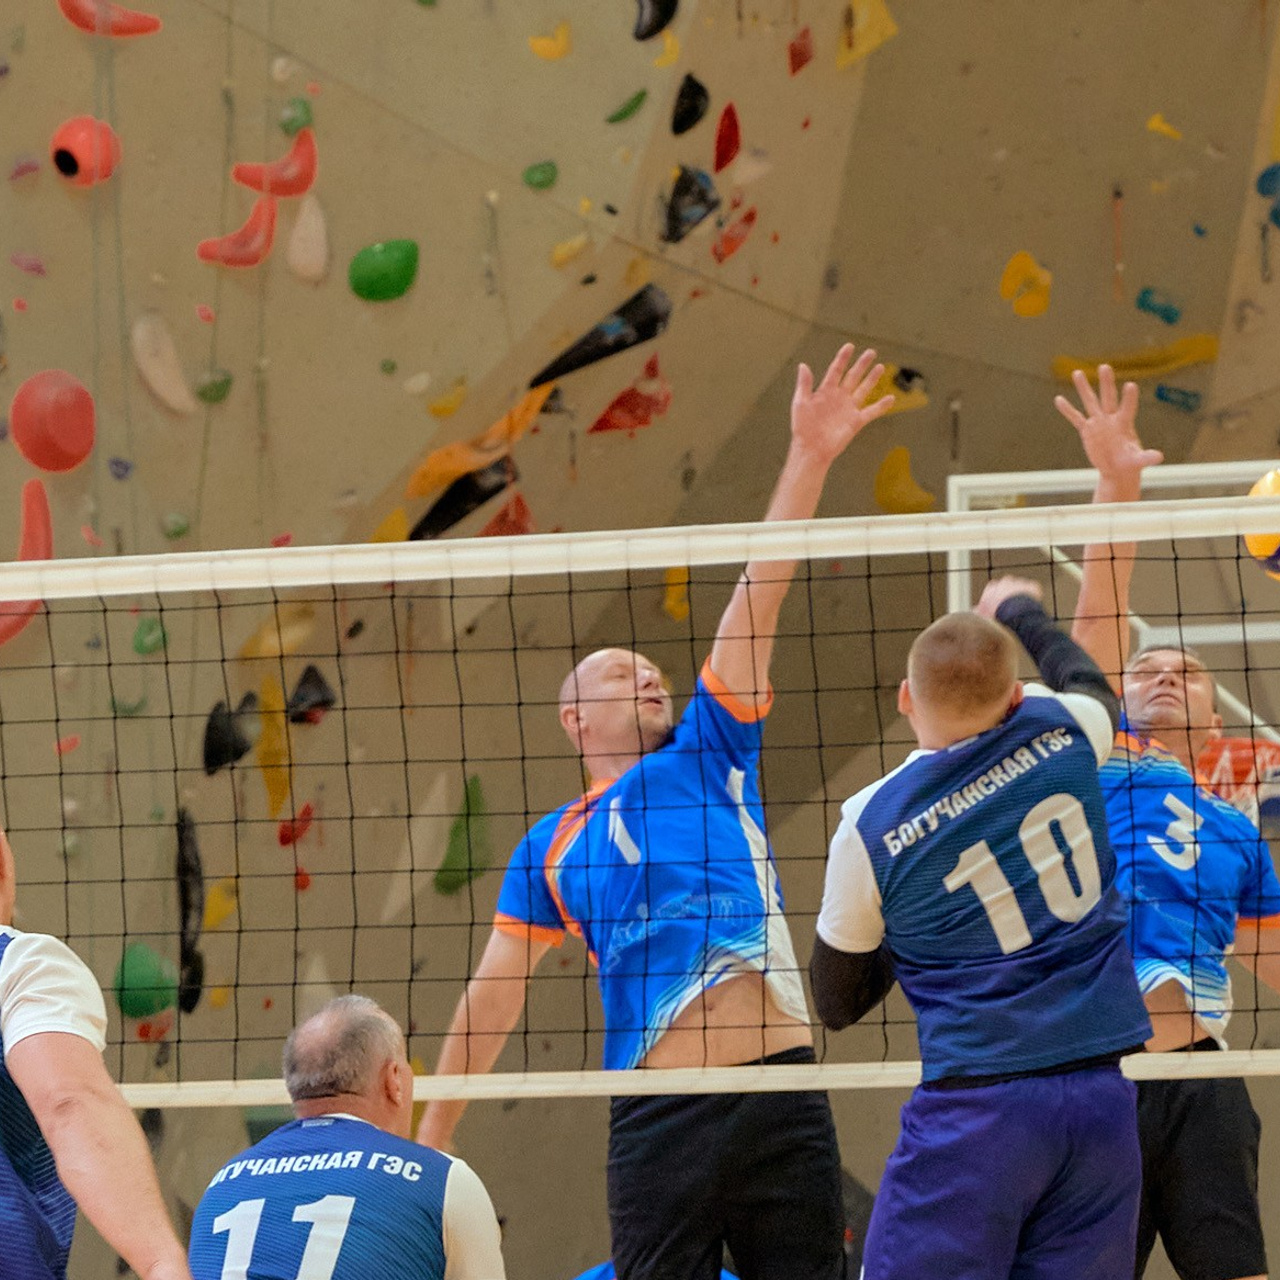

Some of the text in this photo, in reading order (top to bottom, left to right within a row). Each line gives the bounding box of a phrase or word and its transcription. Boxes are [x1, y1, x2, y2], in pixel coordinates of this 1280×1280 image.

[882, 727, 1074, 858] БОГУЧАНСКАЯ ГЭС
[1146, 792, 1205, 871] 3
[942, 793, 1102, 956] 10
[366, 1152, 423, 1181] ГЭС
